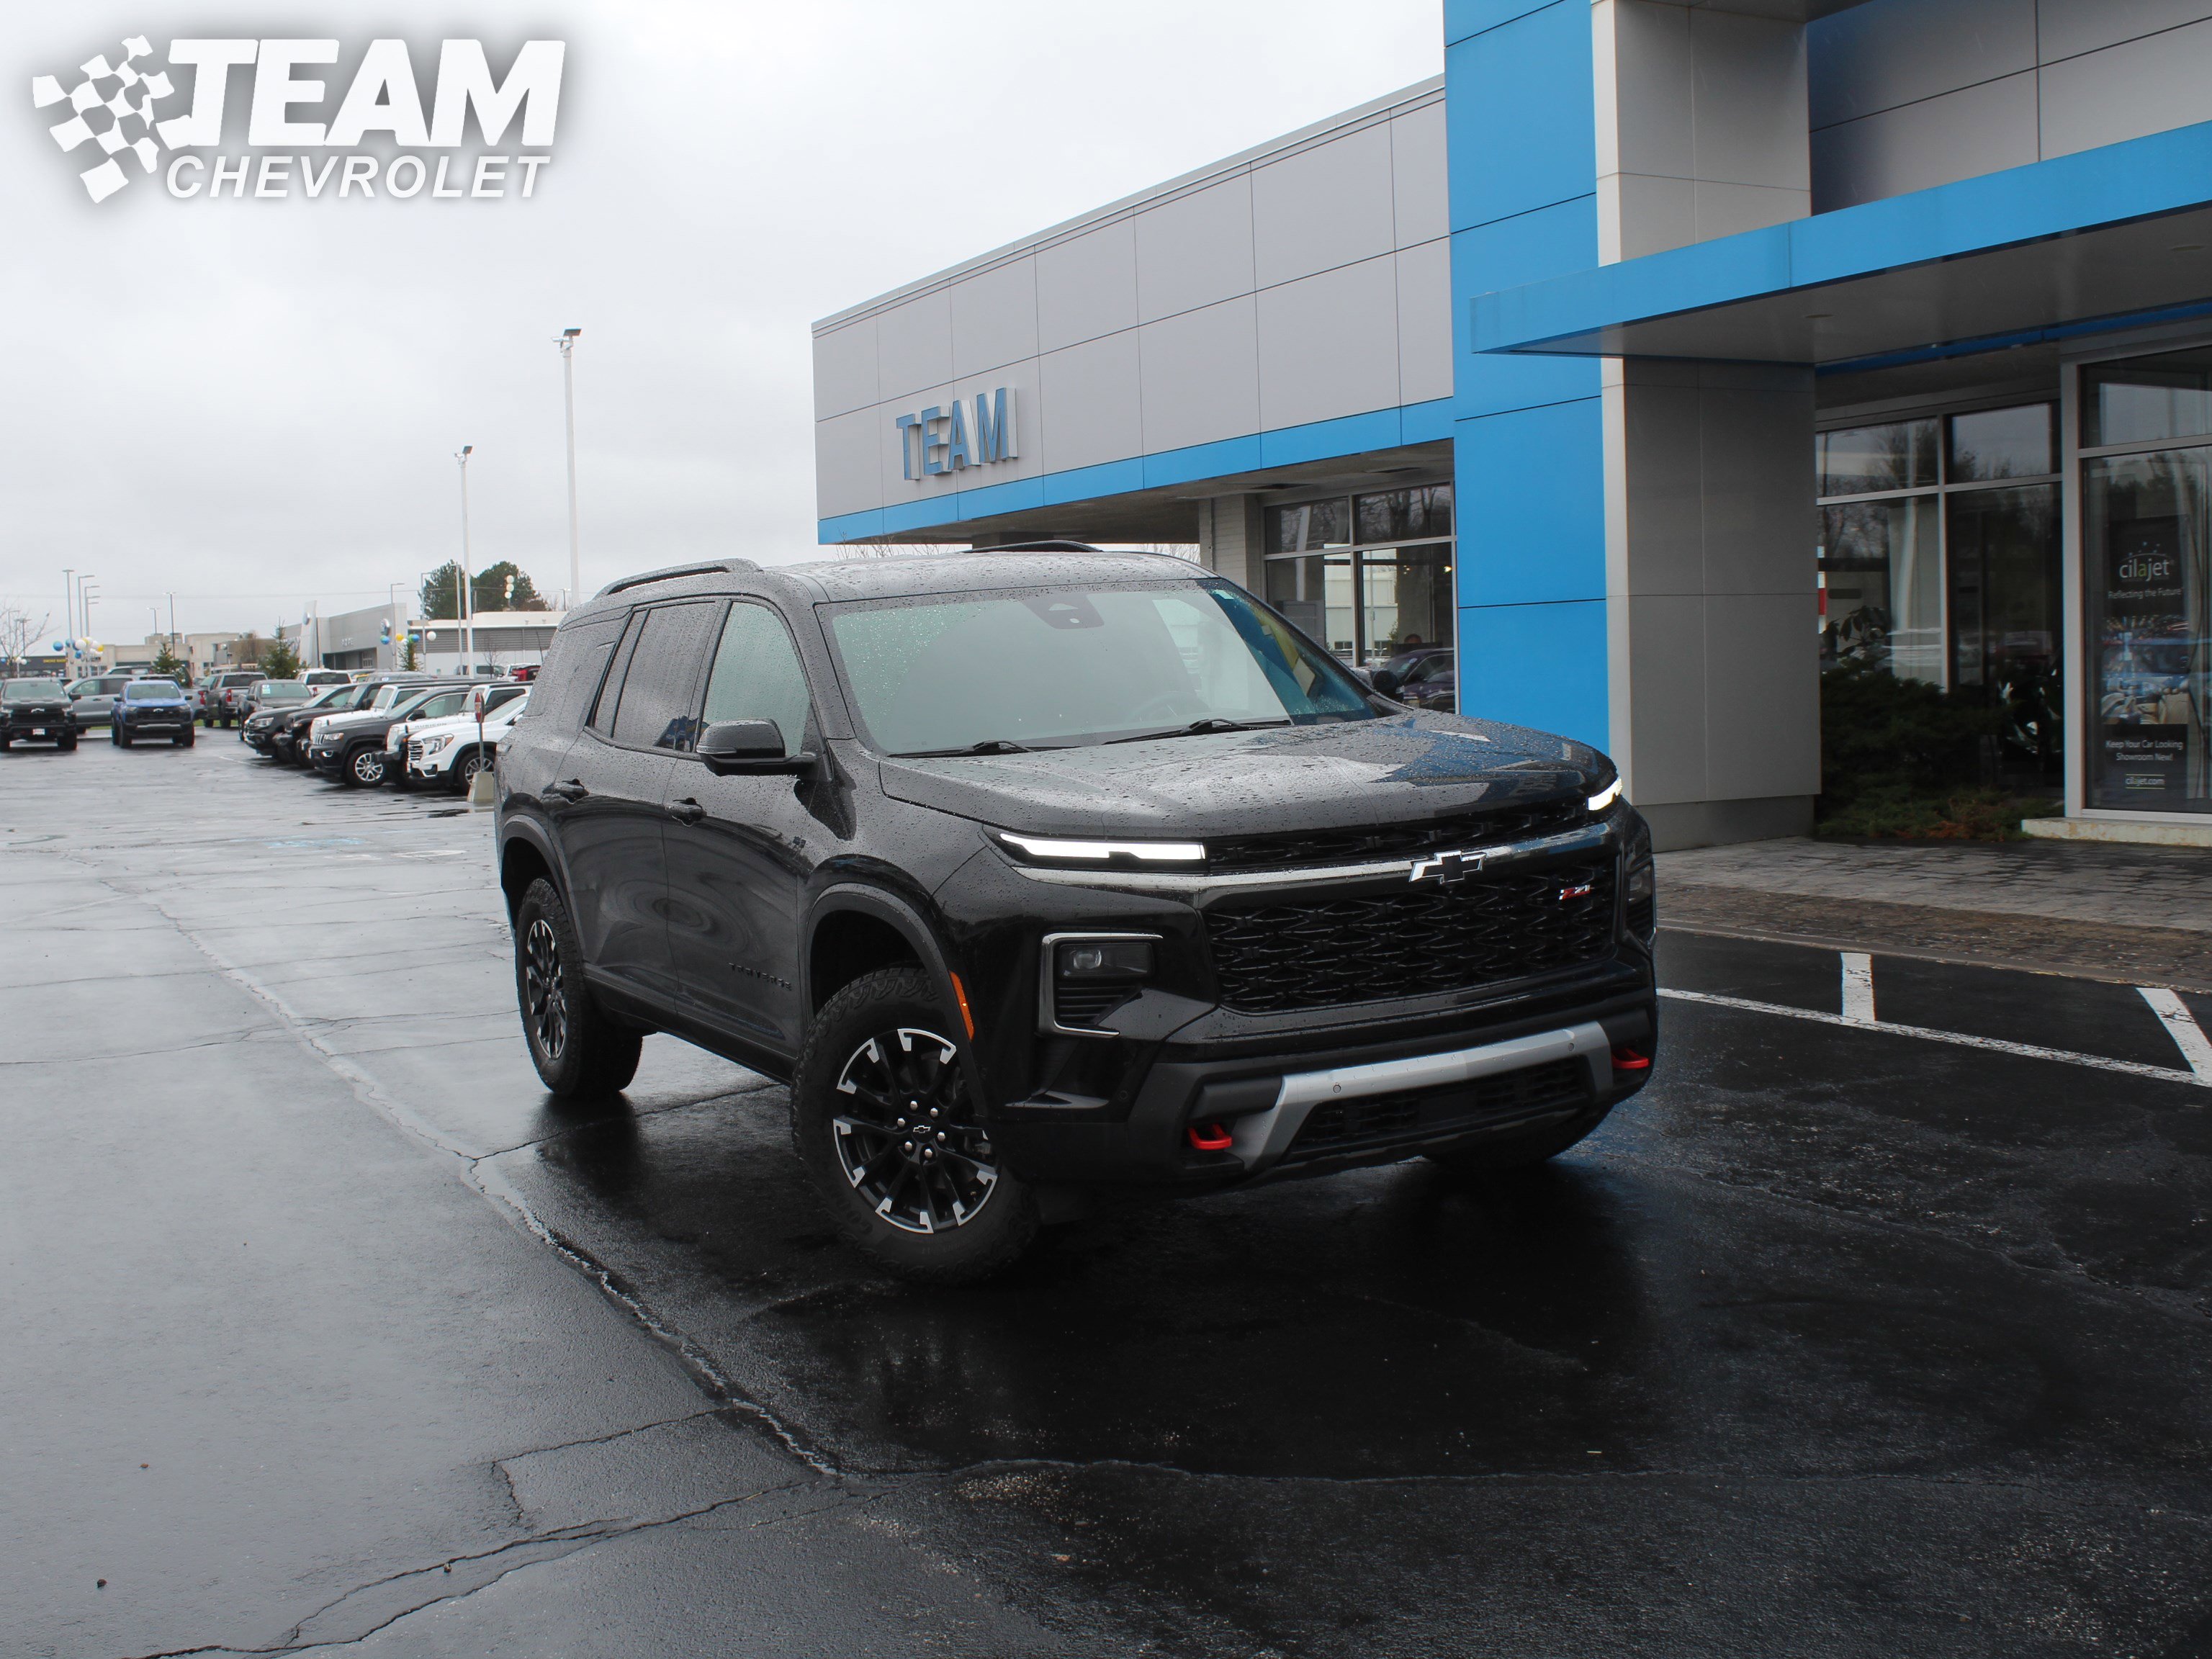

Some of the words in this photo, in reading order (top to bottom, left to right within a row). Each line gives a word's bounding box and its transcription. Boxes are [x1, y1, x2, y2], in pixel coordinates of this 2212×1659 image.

[896, 387, 1018, 480] TEAM
[2119, 558, 2170, 582] cilajet
[2105, 740, 2124, 749] Keep
[2154, 740, 2183, 750] Looking
[2125, 777, 2165, 786] cilajet.com
[1559, 884, 1591, 900] Z71
